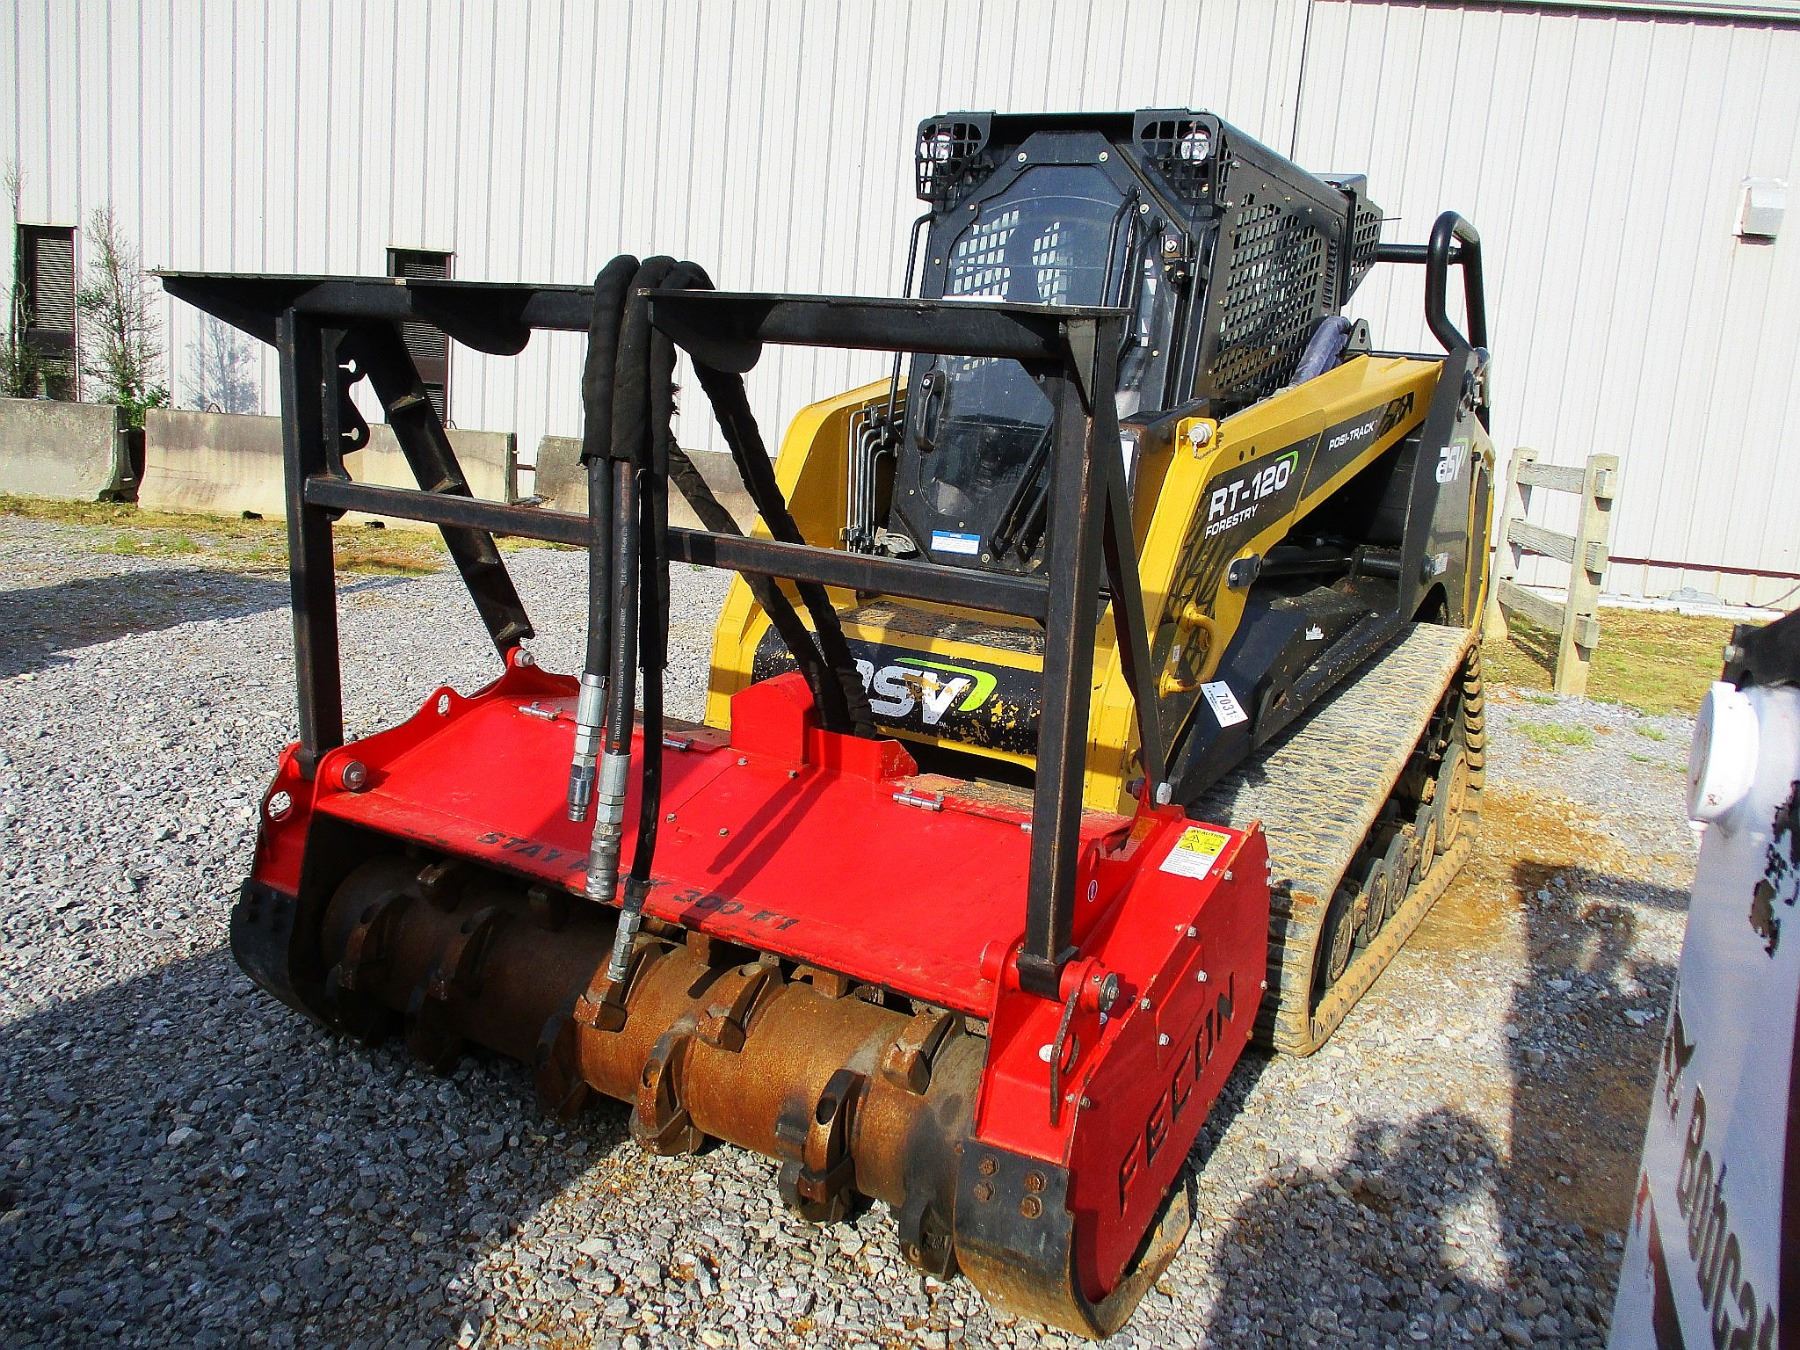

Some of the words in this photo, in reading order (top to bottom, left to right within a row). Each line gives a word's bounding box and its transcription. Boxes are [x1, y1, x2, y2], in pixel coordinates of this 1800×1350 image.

[1328, 423, 1375, 451] POSI-TRACK
[1207, 459, 1291, 521] RT-120
[1205, 504, 1258, 539] FORESTRY
[1214, 690, 1238, 718] 7031
[477, 832, 561, 862] STAY
[674, 888, 744, 915] 300
[1118, 971, 1236, 1218] FECON
